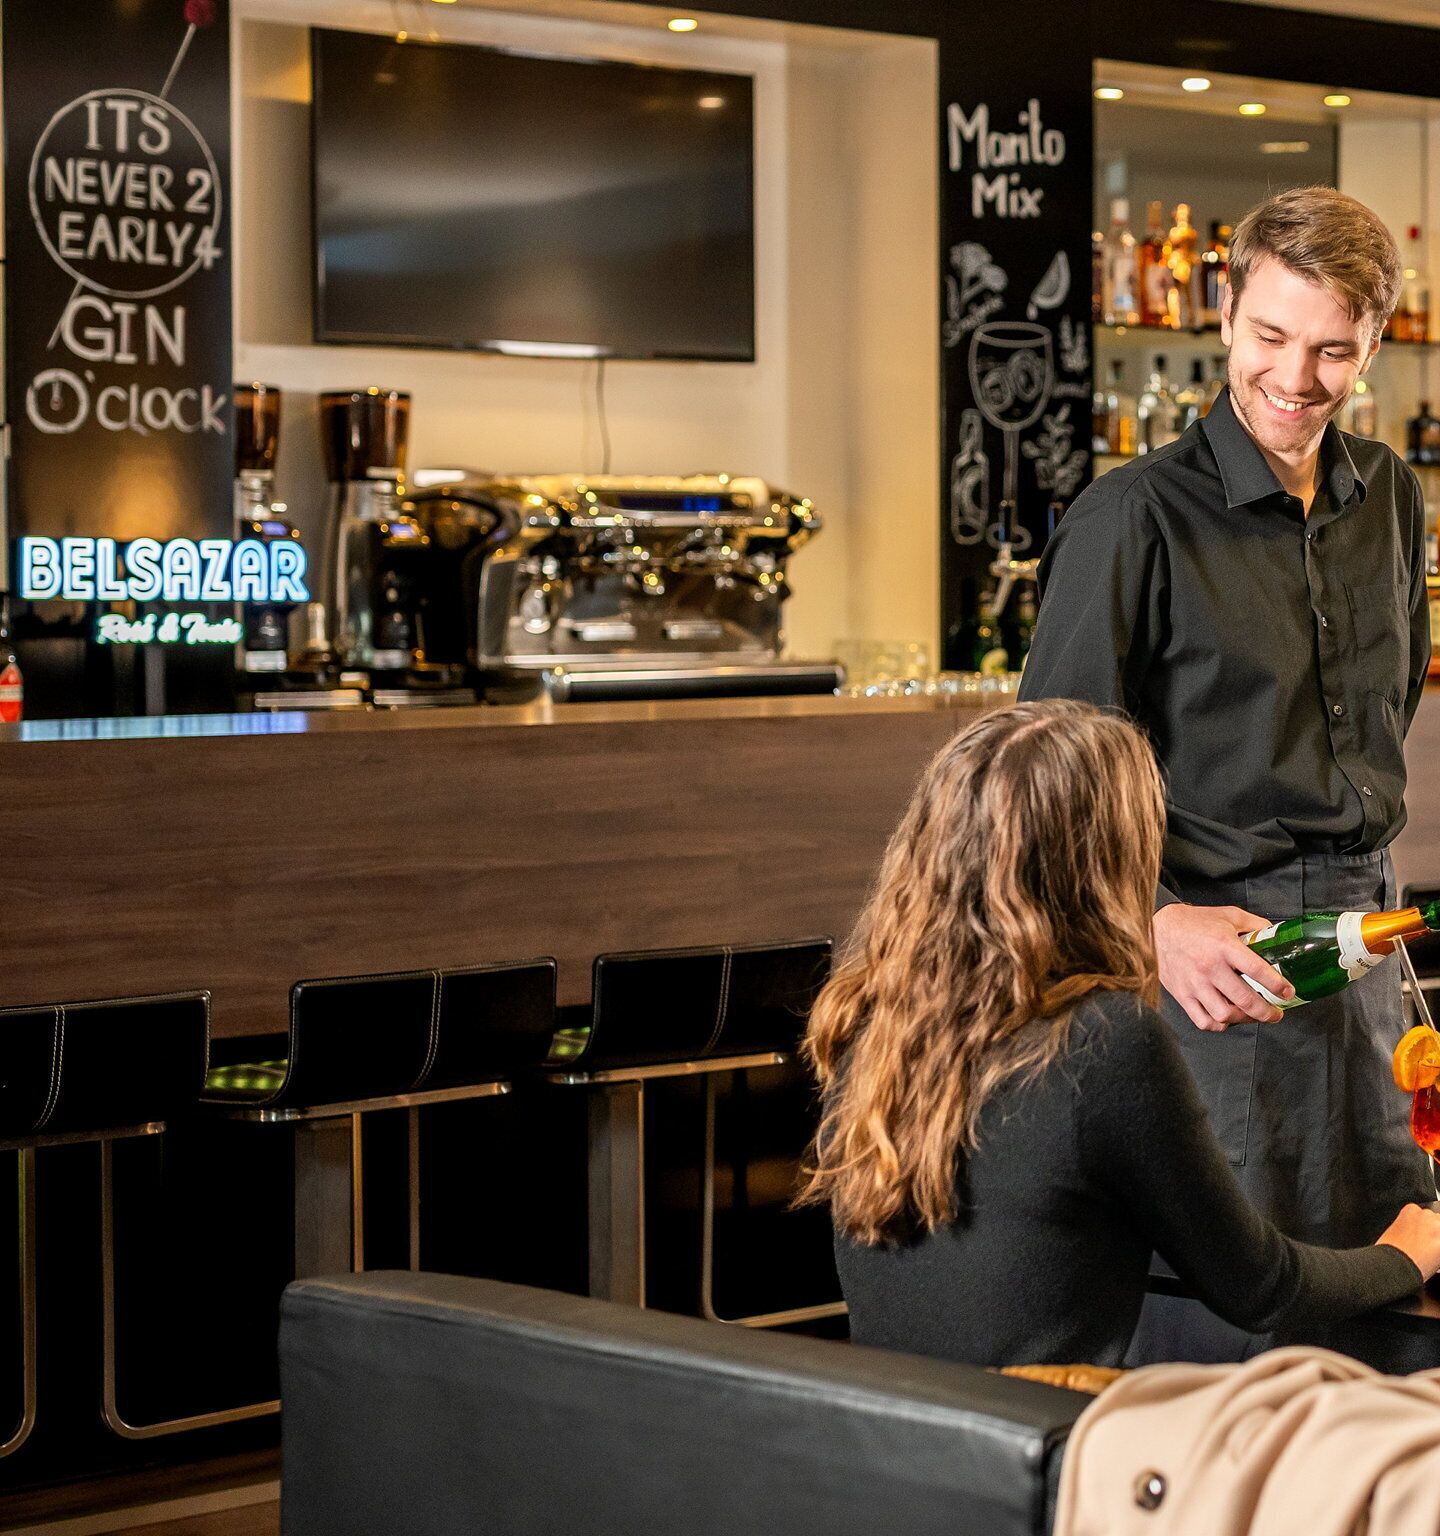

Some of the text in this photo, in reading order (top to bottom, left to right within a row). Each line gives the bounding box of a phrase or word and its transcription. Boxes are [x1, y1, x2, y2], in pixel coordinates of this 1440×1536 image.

[85, 99, 171, 155] ITS
[44, 156, 213, 214] NEVER 2
[971, 171, 1044, 219] Mix
[58, 210, 195, 268] EARLY
[61, 295, 186, 367] GIN
[19, 535, 310, 601] BELSAZAR
